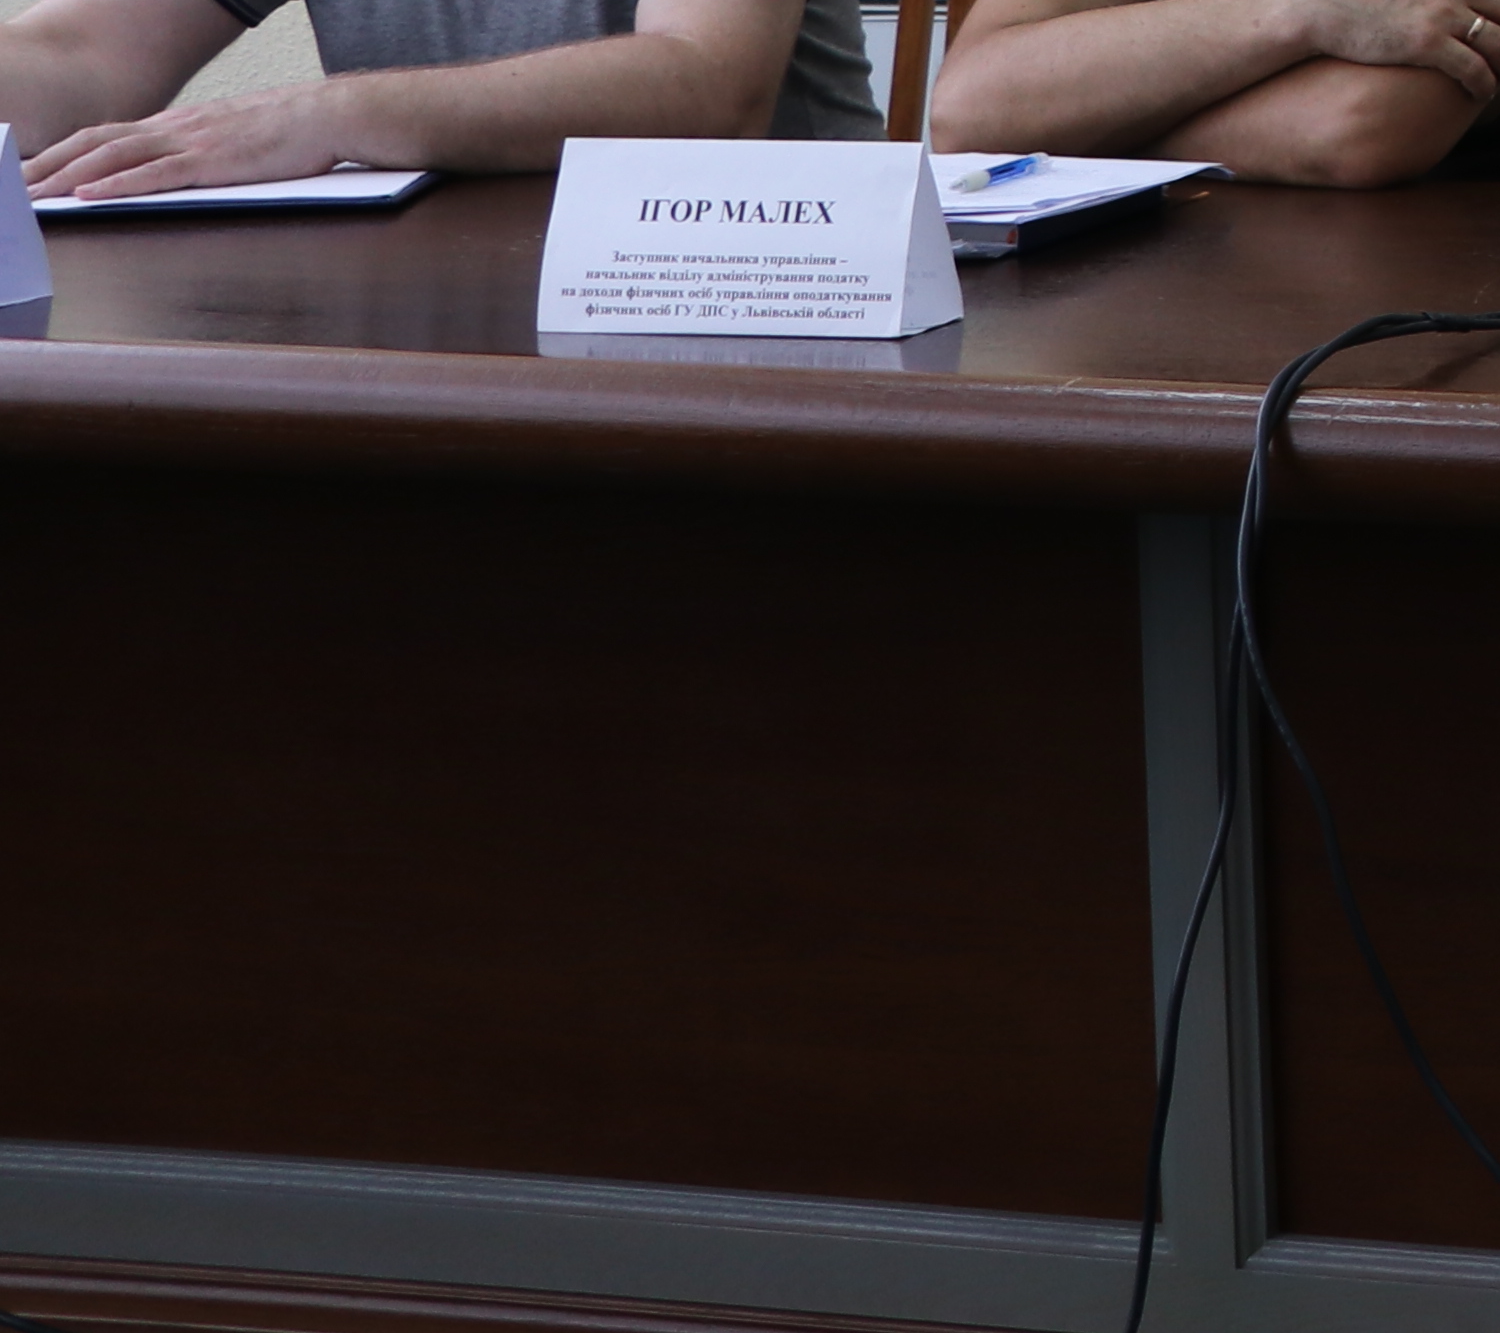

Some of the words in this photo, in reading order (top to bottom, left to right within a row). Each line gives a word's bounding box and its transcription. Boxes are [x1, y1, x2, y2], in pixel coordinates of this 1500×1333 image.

[639, 199, 713, 223] ІГОР
[719, 200, 835, 224] МАЛЕХ
[612, 250, 680, 266] Заступник
[681, 254, 760, 265] начальника
[761, 253, 837, 269] управління
[585, 270, 657, 281] начальник
[658, 268, 704, 285] відділу
[706, 269, 815, 286] адміністрування
[817, 274, 869, 287] податку
[560, 287, 577, 297] на
[578, 287, 623, 298] доходи
[625, 285, 685, 302] фізичних
[687, 286, 713, 299] осіб
[715, 287, 790, 303] управління
[792, 291, 893, 305] оподаткування
[584, 302, 644, 318] фізичних
[646, 303, 672, 316] осіб
[674, 303, 695, 317] ГУ
[695, 304, 729, 319] ДПС
[730, 308, 739, 321] у
[741, 305, 814, 319] Львівській
[816, 306, 865, 320] області
